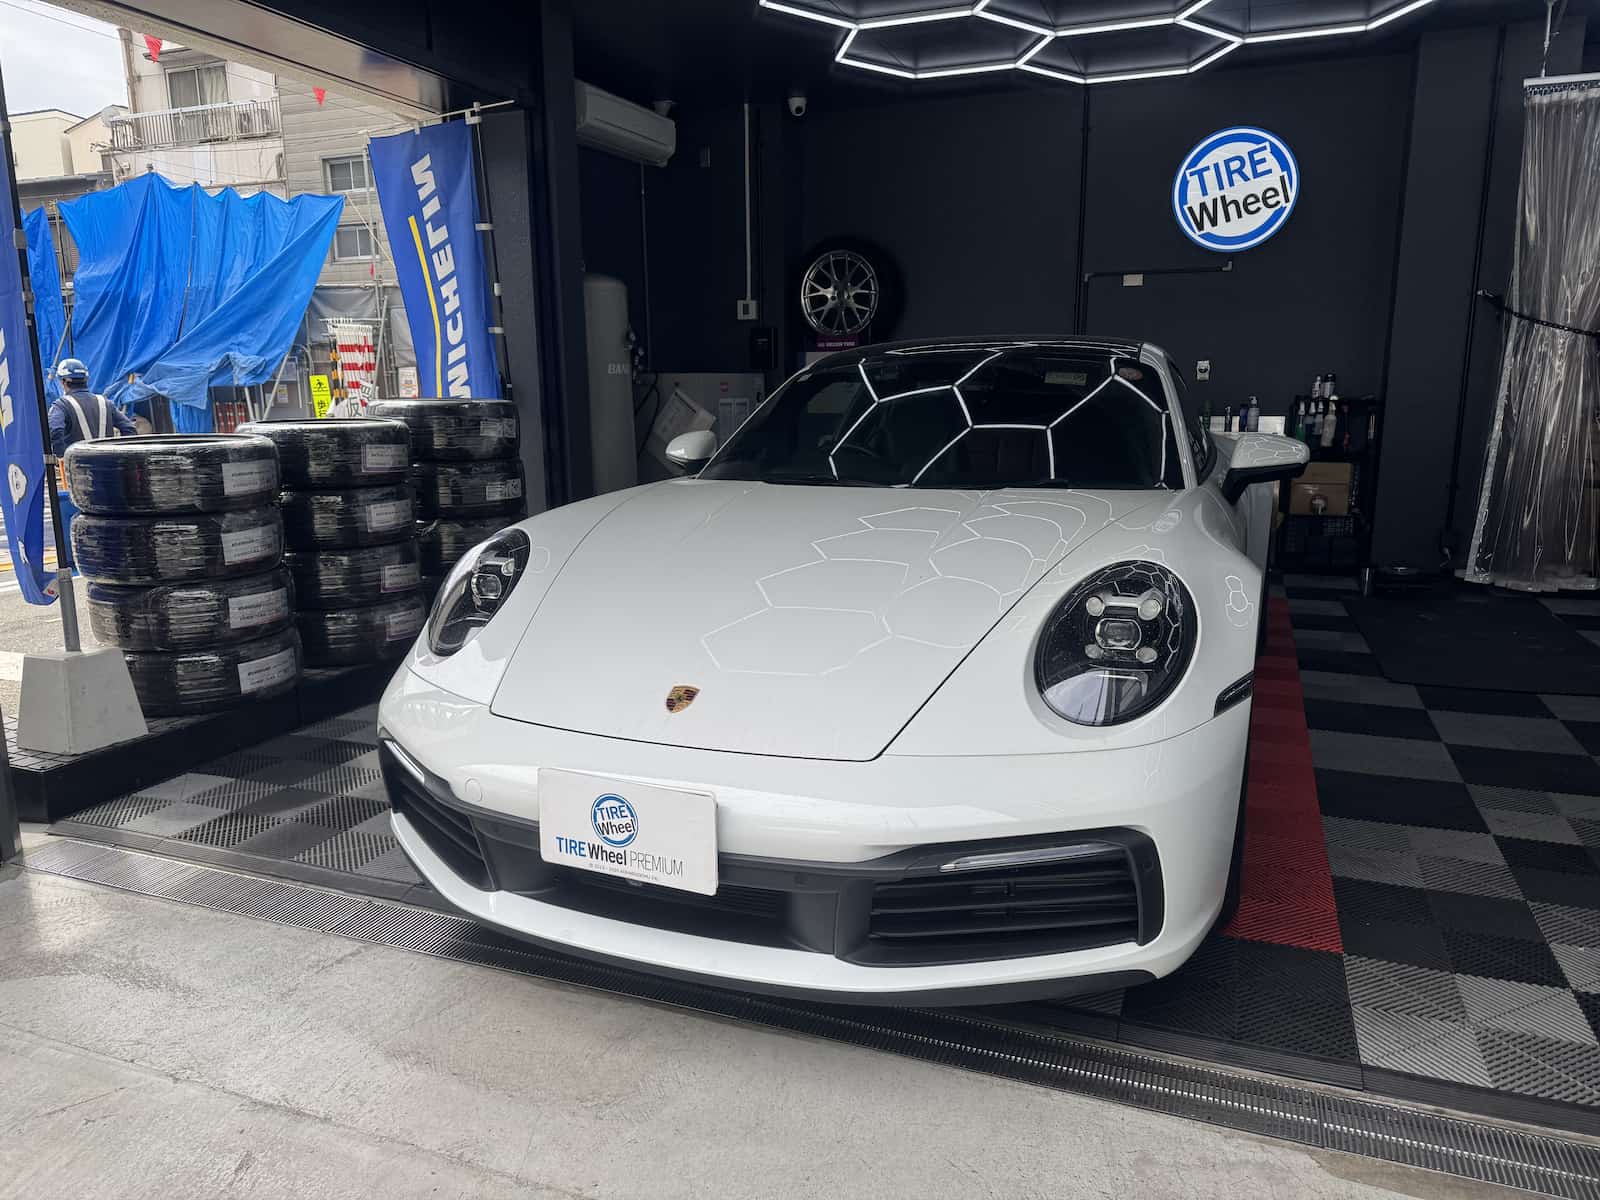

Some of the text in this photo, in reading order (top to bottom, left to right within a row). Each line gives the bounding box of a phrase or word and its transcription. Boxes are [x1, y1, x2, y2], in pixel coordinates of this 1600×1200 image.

[1189, 145, 1273, 197] TIRE
[1187, 175, 1290, 232] Wheel
[597, 804, 628, 820] TIRE
[597, 818, 635, 836] Wheel
[555, 836, 587, 857] TIRE
[588, 841, 627, 865] Wheel
[629, 850, 683, 877] PREMIUM
